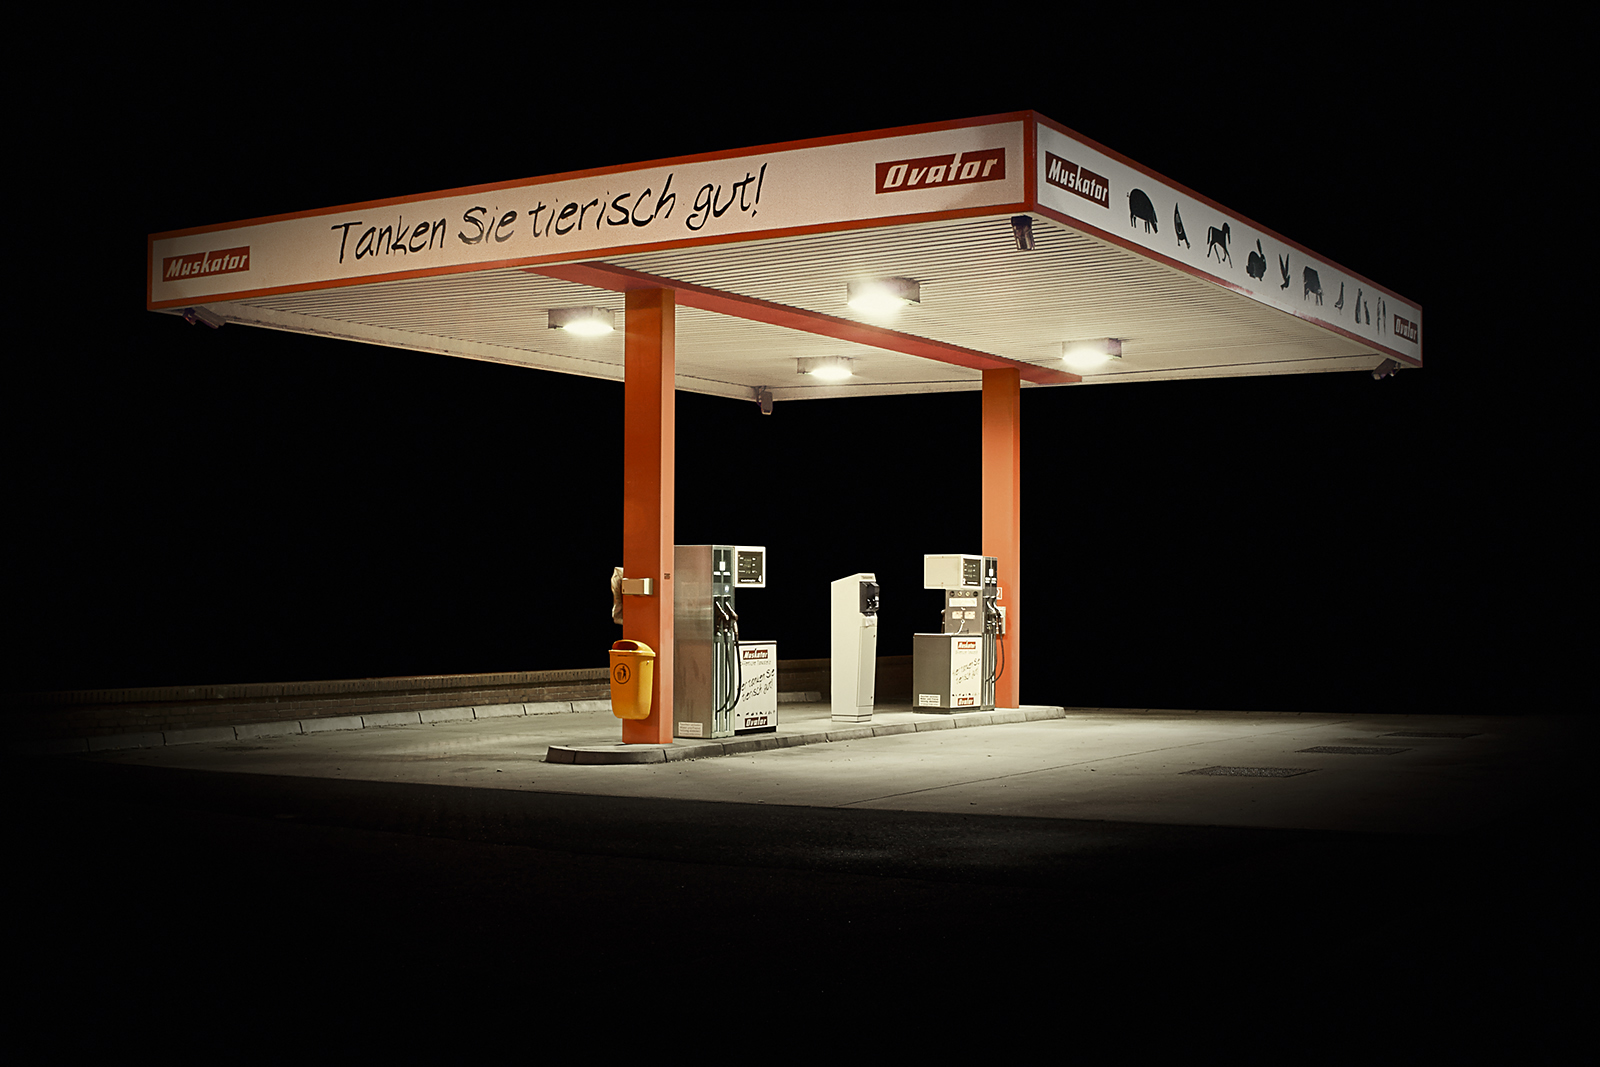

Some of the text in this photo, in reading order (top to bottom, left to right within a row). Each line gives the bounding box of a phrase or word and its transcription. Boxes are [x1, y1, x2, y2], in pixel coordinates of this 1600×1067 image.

[883, 152, 998, 189] Ovator
[1048, 155, 1108, 202] Muskator
[331, 162, 767, 264] Tanken Sie tierisch gut!
[166, 251, 248, 278] Muskator
[1395, 318, 1418, 341] Ovator
[743, 648, 768, 659] Muskator
[745, 716, 767, 727] Ovator
